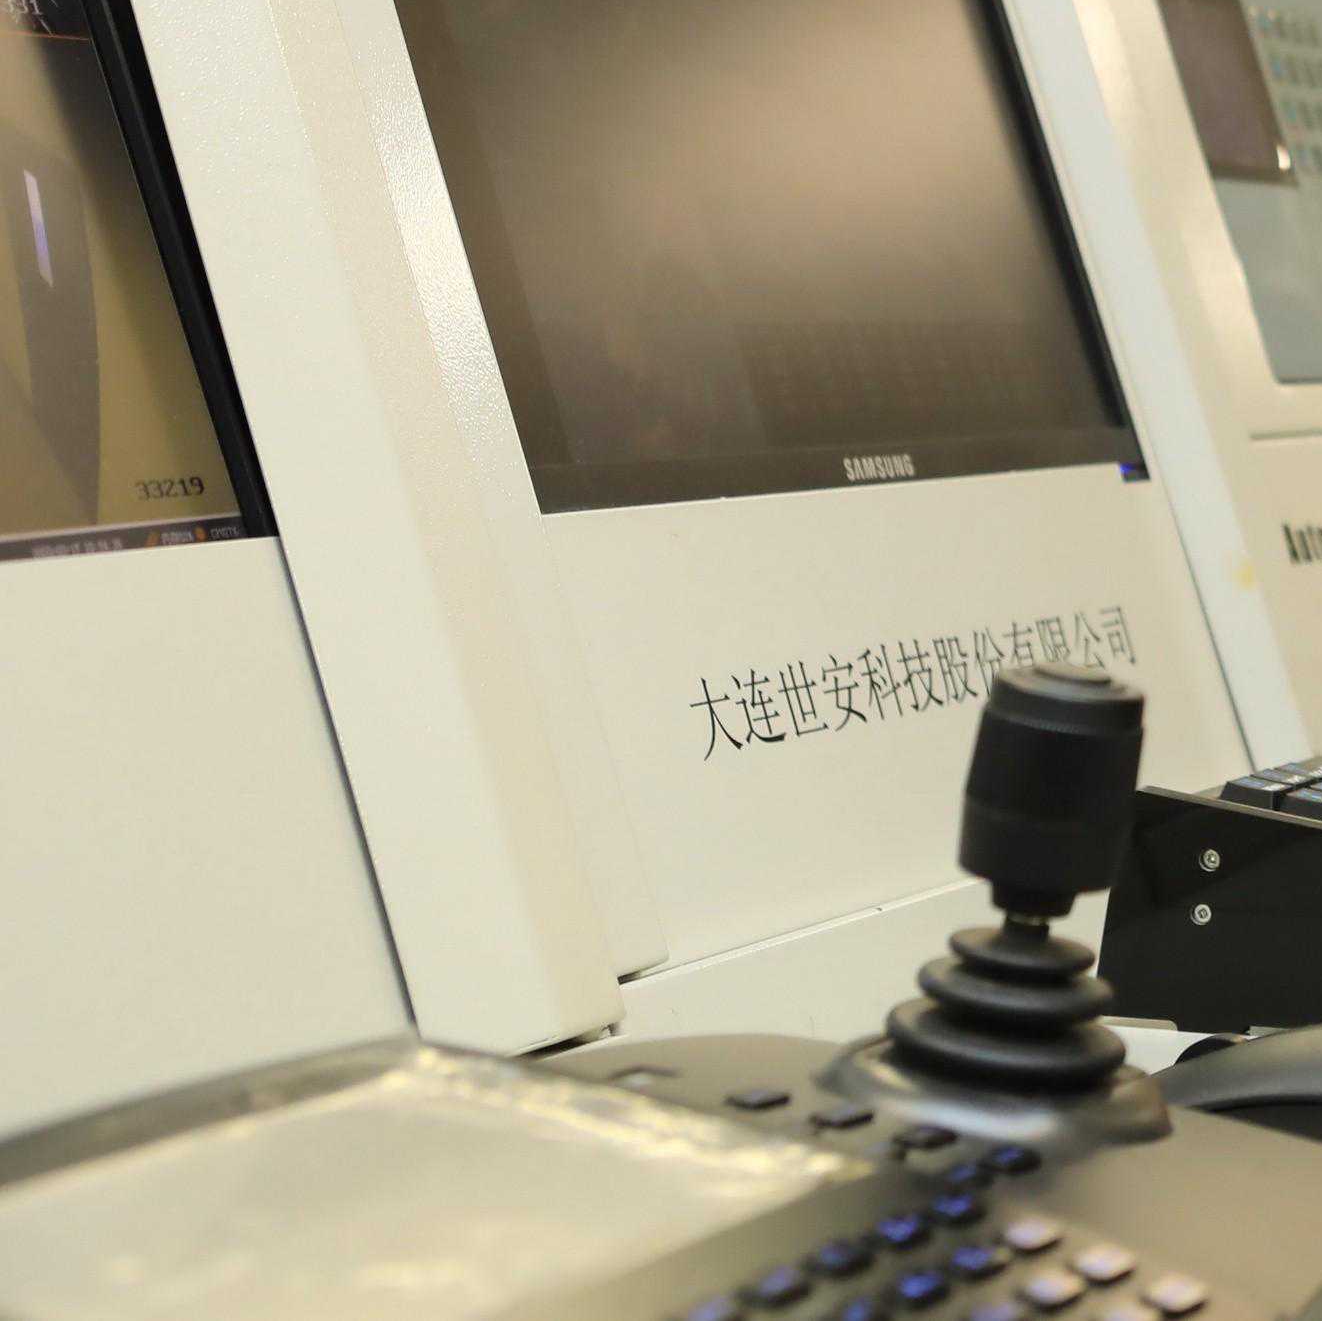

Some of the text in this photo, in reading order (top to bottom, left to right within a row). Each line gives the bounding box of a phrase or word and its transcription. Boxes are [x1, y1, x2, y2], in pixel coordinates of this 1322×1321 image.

[842, 454, 915, 482] SAMSUNG
[689, 605, 1137, 762] 大连世安科技股份有限公司
